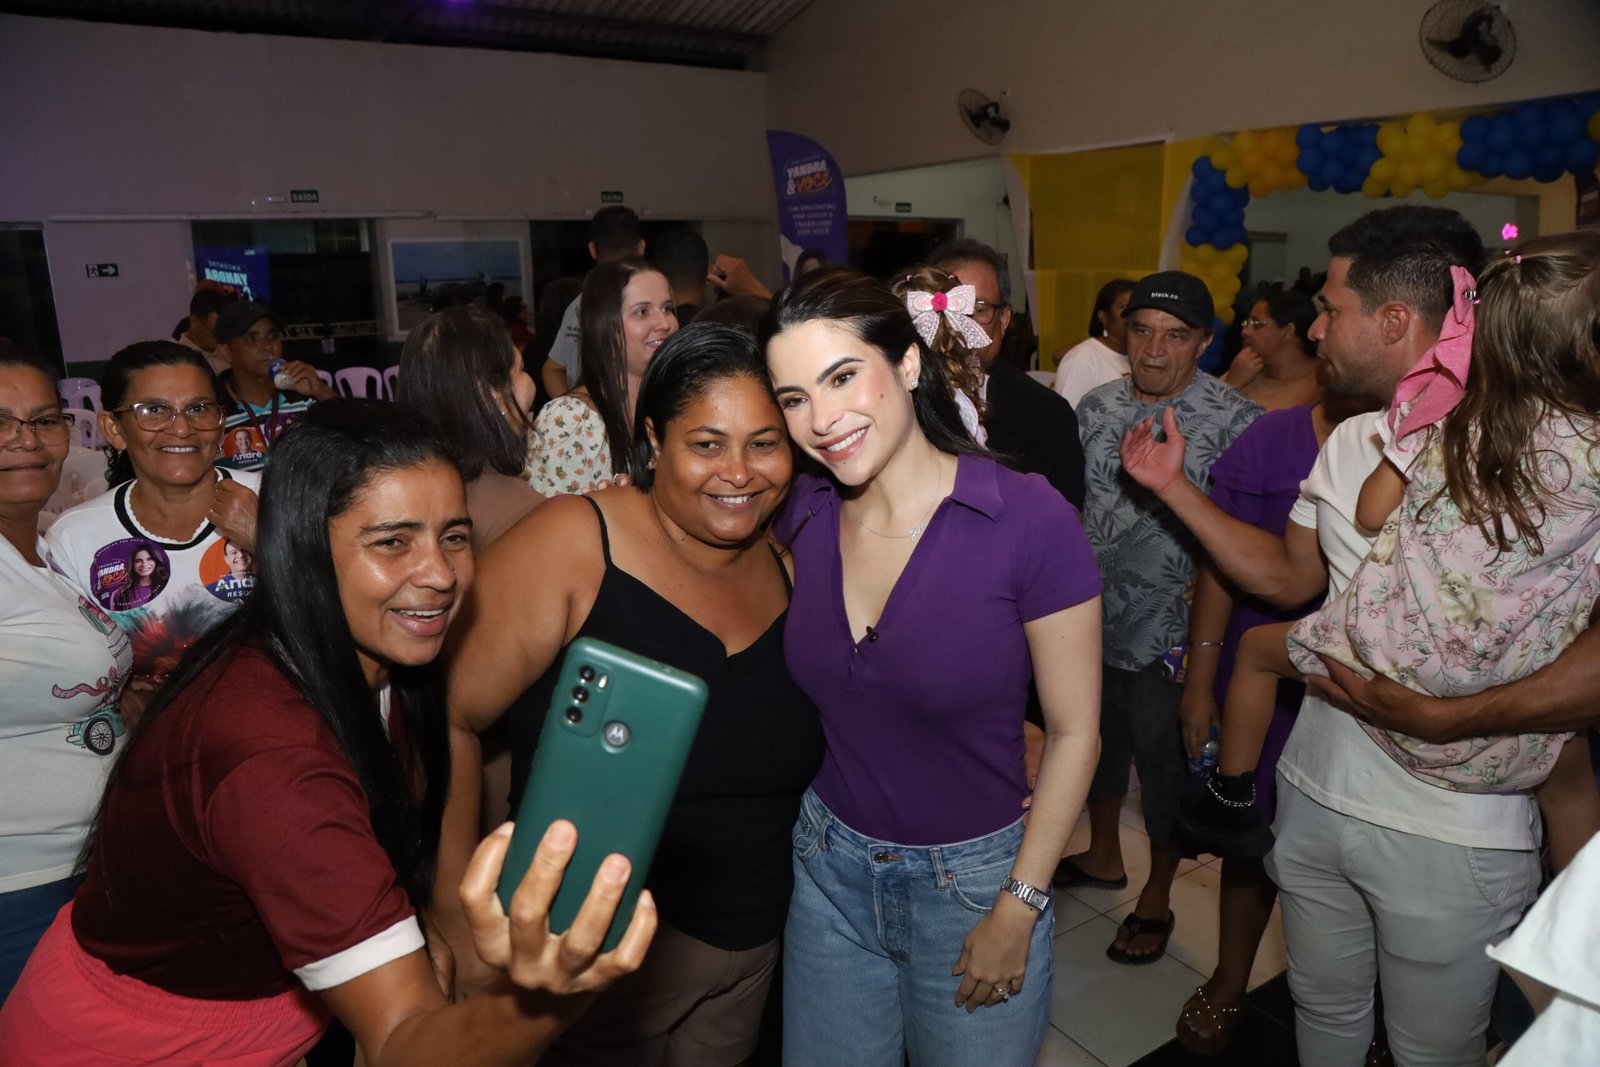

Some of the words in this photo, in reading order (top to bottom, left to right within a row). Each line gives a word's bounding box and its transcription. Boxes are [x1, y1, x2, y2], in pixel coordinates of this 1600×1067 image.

[786, 160, 827, 178] YANDRA
[786, 178, 796, 195] &
[232, 450, 262, 462] André
[215, 575, 254, 592] And
